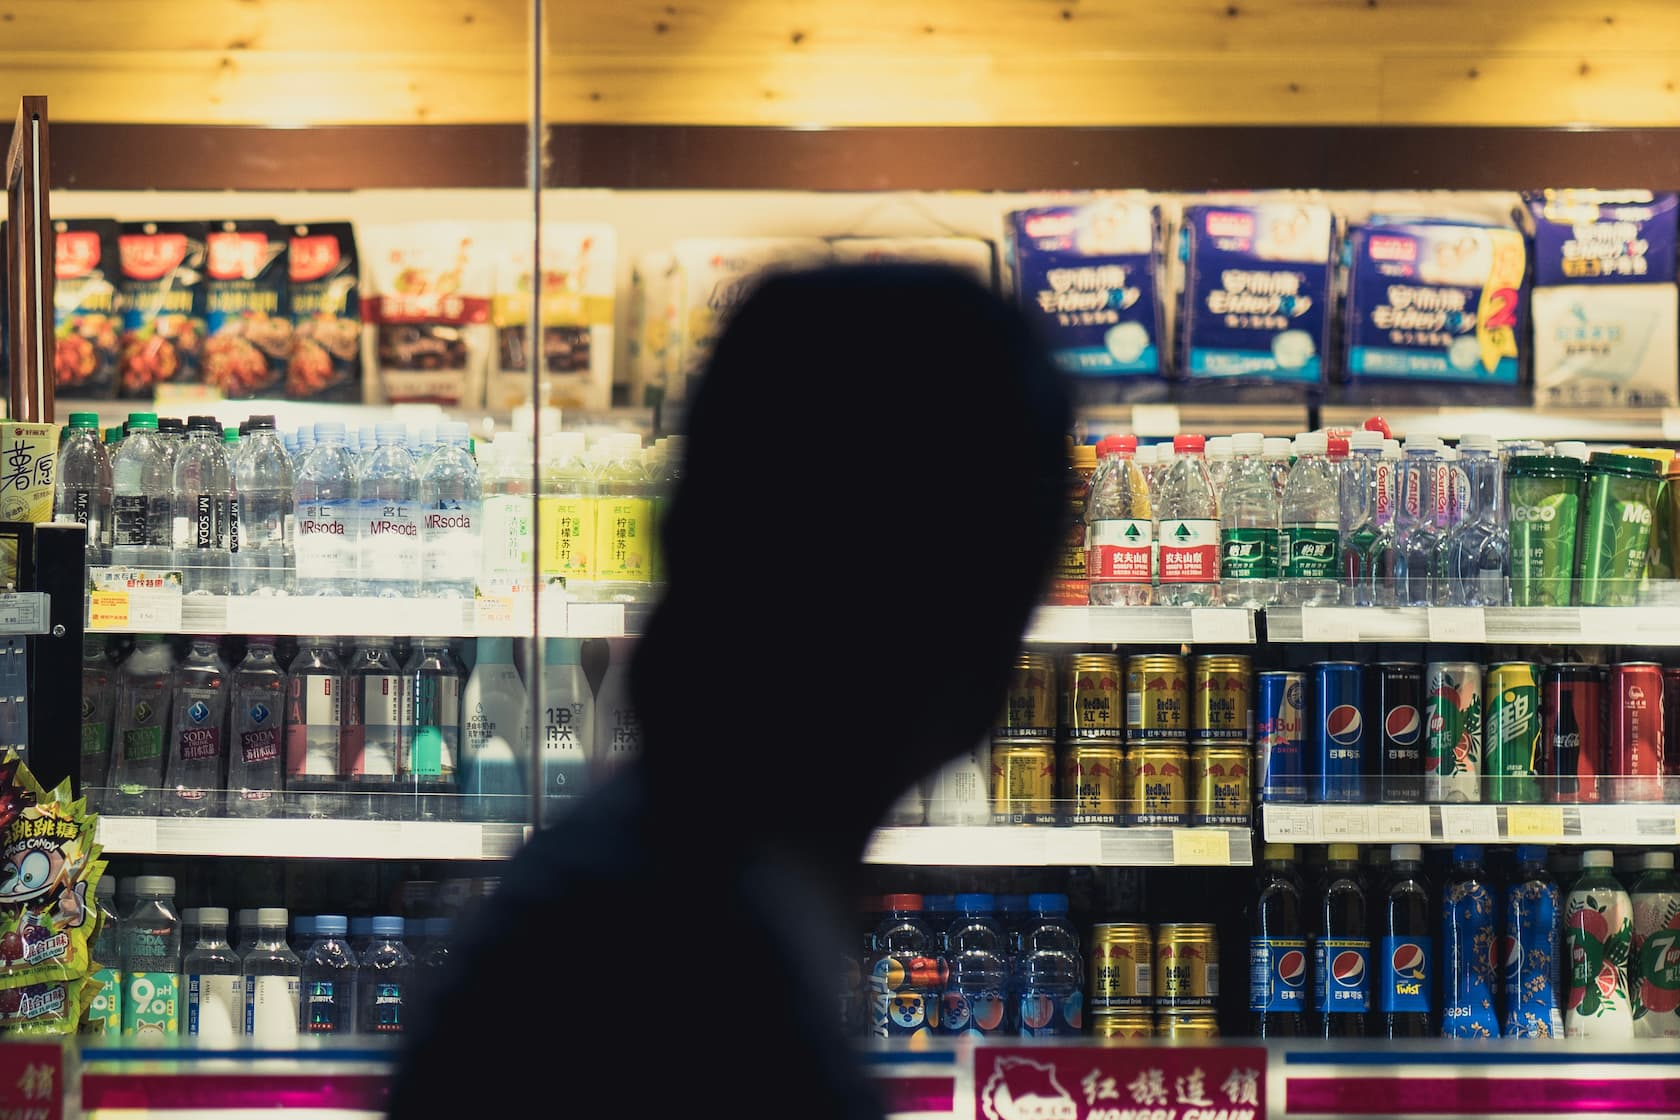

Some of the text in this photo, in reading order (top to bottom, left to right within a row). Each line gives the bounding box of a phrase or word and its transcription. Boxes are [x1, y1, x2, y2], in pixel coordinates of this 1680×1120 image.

[0, 440, 55, 492] 薯愿
[370, 520, 417, 536] MRsoda
[424, 514, 471, 529] MRsoda
[1165, 552, 1203, 564] 农夫山泉
[1083, 710, 1110, 722] 红牛
[1156, 711, 1181, 722] 红牛
[1209, 711, 1235, 722] 红牛
[1257, 718, 1273, 732] ed
[26, 838, 59, 853] CANDY
[1651, 936, 1677, 972] 7
[1081, 1067, 1260, 1107] 红旗连锁
